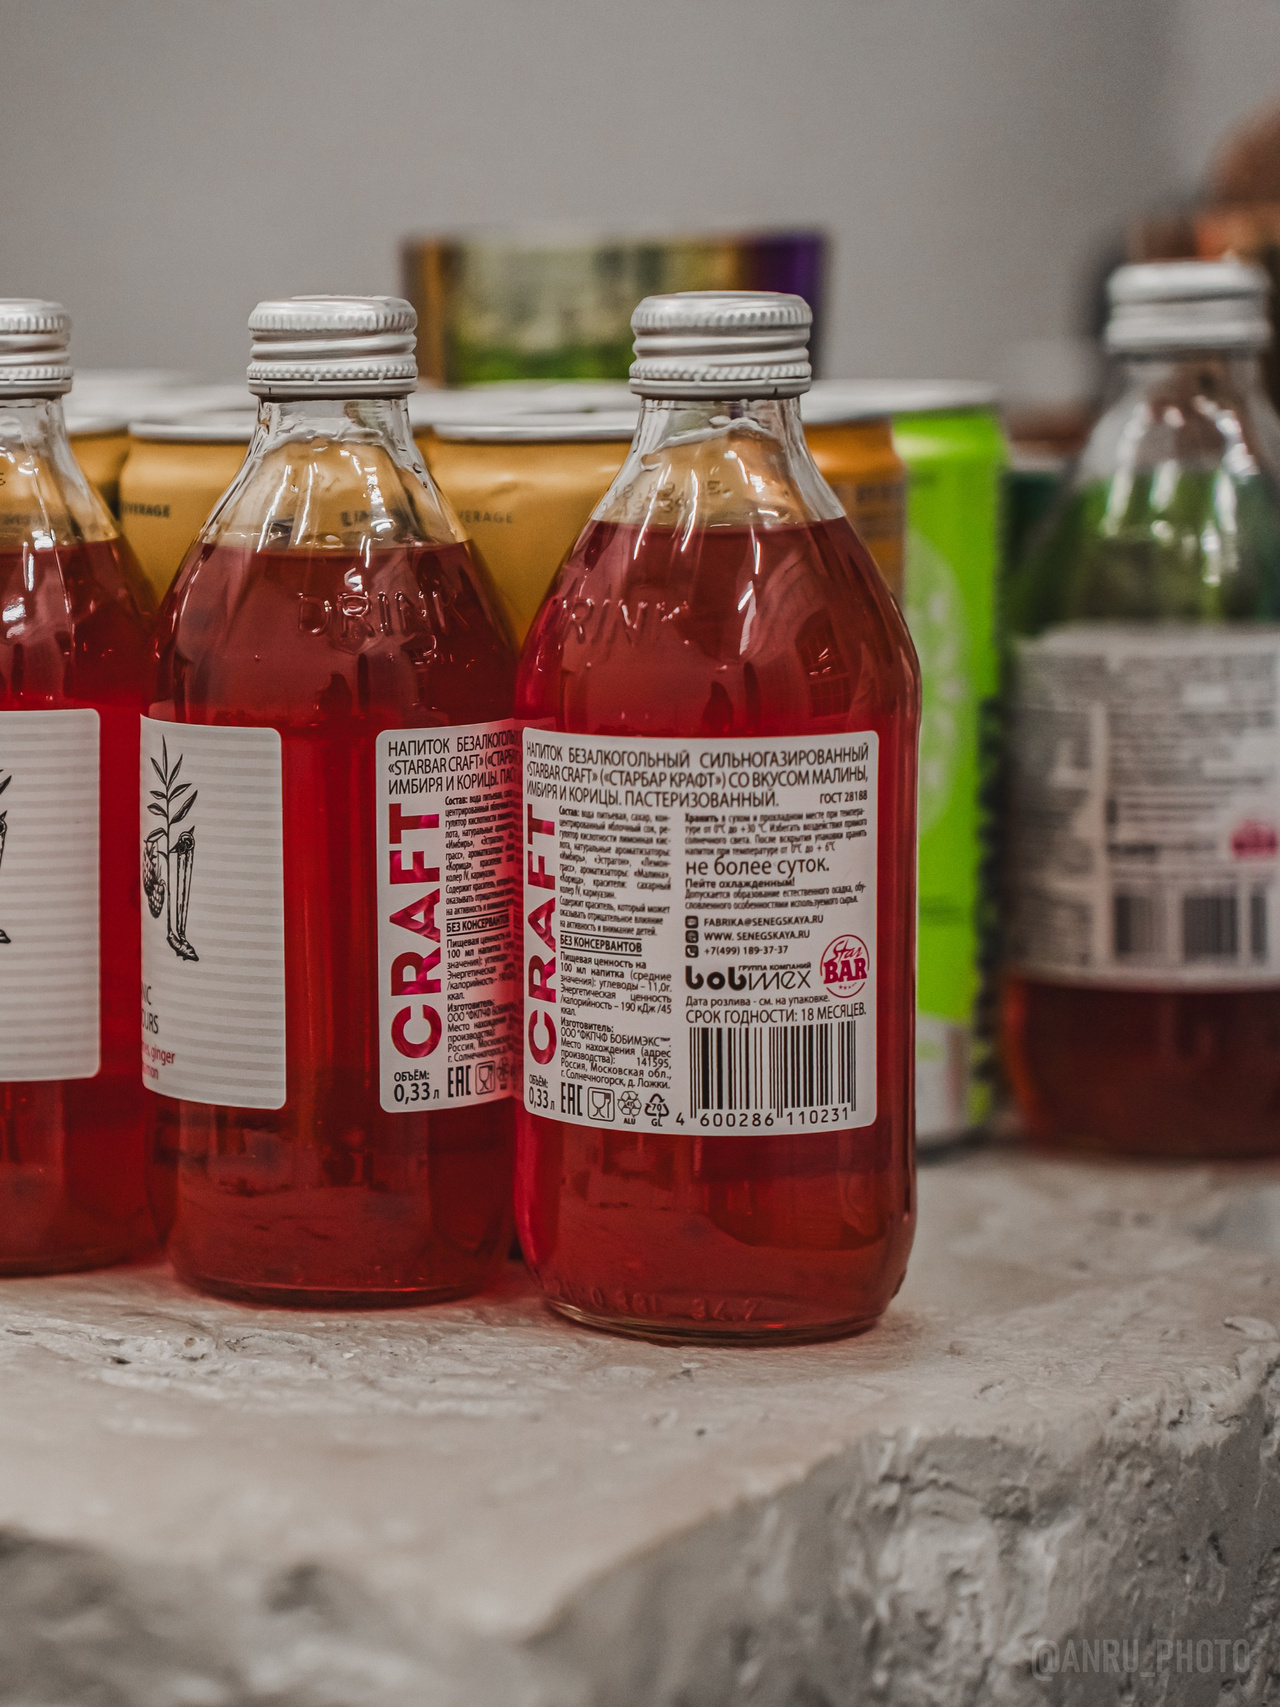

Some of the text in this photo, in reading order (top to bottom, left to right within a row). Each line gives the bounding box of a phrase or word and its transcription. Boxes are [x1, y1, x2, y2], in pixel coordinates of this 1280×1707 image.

[389, 738, 450, 756] НАПИТОК
[527, 741, 868, 768] НАПИТОК БЕЗАЛКОГОЛЬНЫЙ СИЛЬНОГАЗИРОВАННЫЙ
[388, 753, 483, 775] «STARBAR CRAFT»
[389, 777, 442, 795] ИМБИРЯ
[446, 776, 454, 791] И
[729, 772, 749, 788] СО
[753, 770, 809, 787] ВКУСОМ
[812, 765, 868, 784] МАЛИНЫ,
[527, 780, 779, 808] ИМБИРЯ И КОРИЦЫ. ПАСТЕРИЗОВАННЫЙ.
[820, 790, 867, 804] ГОСТ 28188
[686, 854, 829, 879] не более суток.
[686, 878, 795, 889] Пейте охлажденным!
[447, 922, 460, 933] БЕЗ
[704, 915, 823, 927] FABRIKA@SENEGSKAYA.RU
[388, 803, 442, 1058] CRAFT
[527, 803, 557, 1064] CRAFT
[737, 930, 810, 940] SENEGSKAYA.RU
[447, 938, 479, 948] Пищевая
[561, 935, 642, 952] БЕЗ КОНСЕРВАНТОВ
[704, 945, 788, 956] +7(499) 189-37-37
[833, 938, 862, 961] Star
[447, 949, 460, 958] 100
[561, 952, 646, 969] Пищевая ценность на
[561, 963, 672, 981] 100 мл напитка (средние
[770, 962, 811, 970] КОМПАНИЙ
[823, 958, 867, 985] BAR
[561, 984, 672, 1003] Энергетическая ценность
[600, 980, 638, 990] углеводы
[621, 1002, 635, 1012] 190
[637, 1004, 655, 1013] кДж
[686, 997, 708, 1007] Дата
[711, 998, 751, 1008] розлива
[789, 994, 830, 1006] упаковке.
[448, 1012, 464, 1022] ООО
[686, 1002, 866, 1026] СРОК ГОДНОСТИ: 18 МЕСЯЦЕВ.
[448, 1024, 470, 1032] Место
[561, 1017, 614, 1033] Изготовитель:
[561, 1027, 576, 1038] ООО
[151, 1045, 175, 1066] ginger
[561, 1038, 671, 1058] Место нахождения (адрес
[394, 1070, 429, 1081] ОБЪЁМ:
[561, 1058, 588, 1071] Россия,
[590, 1064, 644, 1077] Московская
[566, 1069, 625, 1087] Солнечногорск,
[394, 1083, 440, 1104] 0,33 л
[529, 1087, 554, 1110] 0,33 л
[651, 1118, 662, 1126] GL
[700, 1113, 774, 1127] 600286
[787, 1107, 848, 1126] 110231
